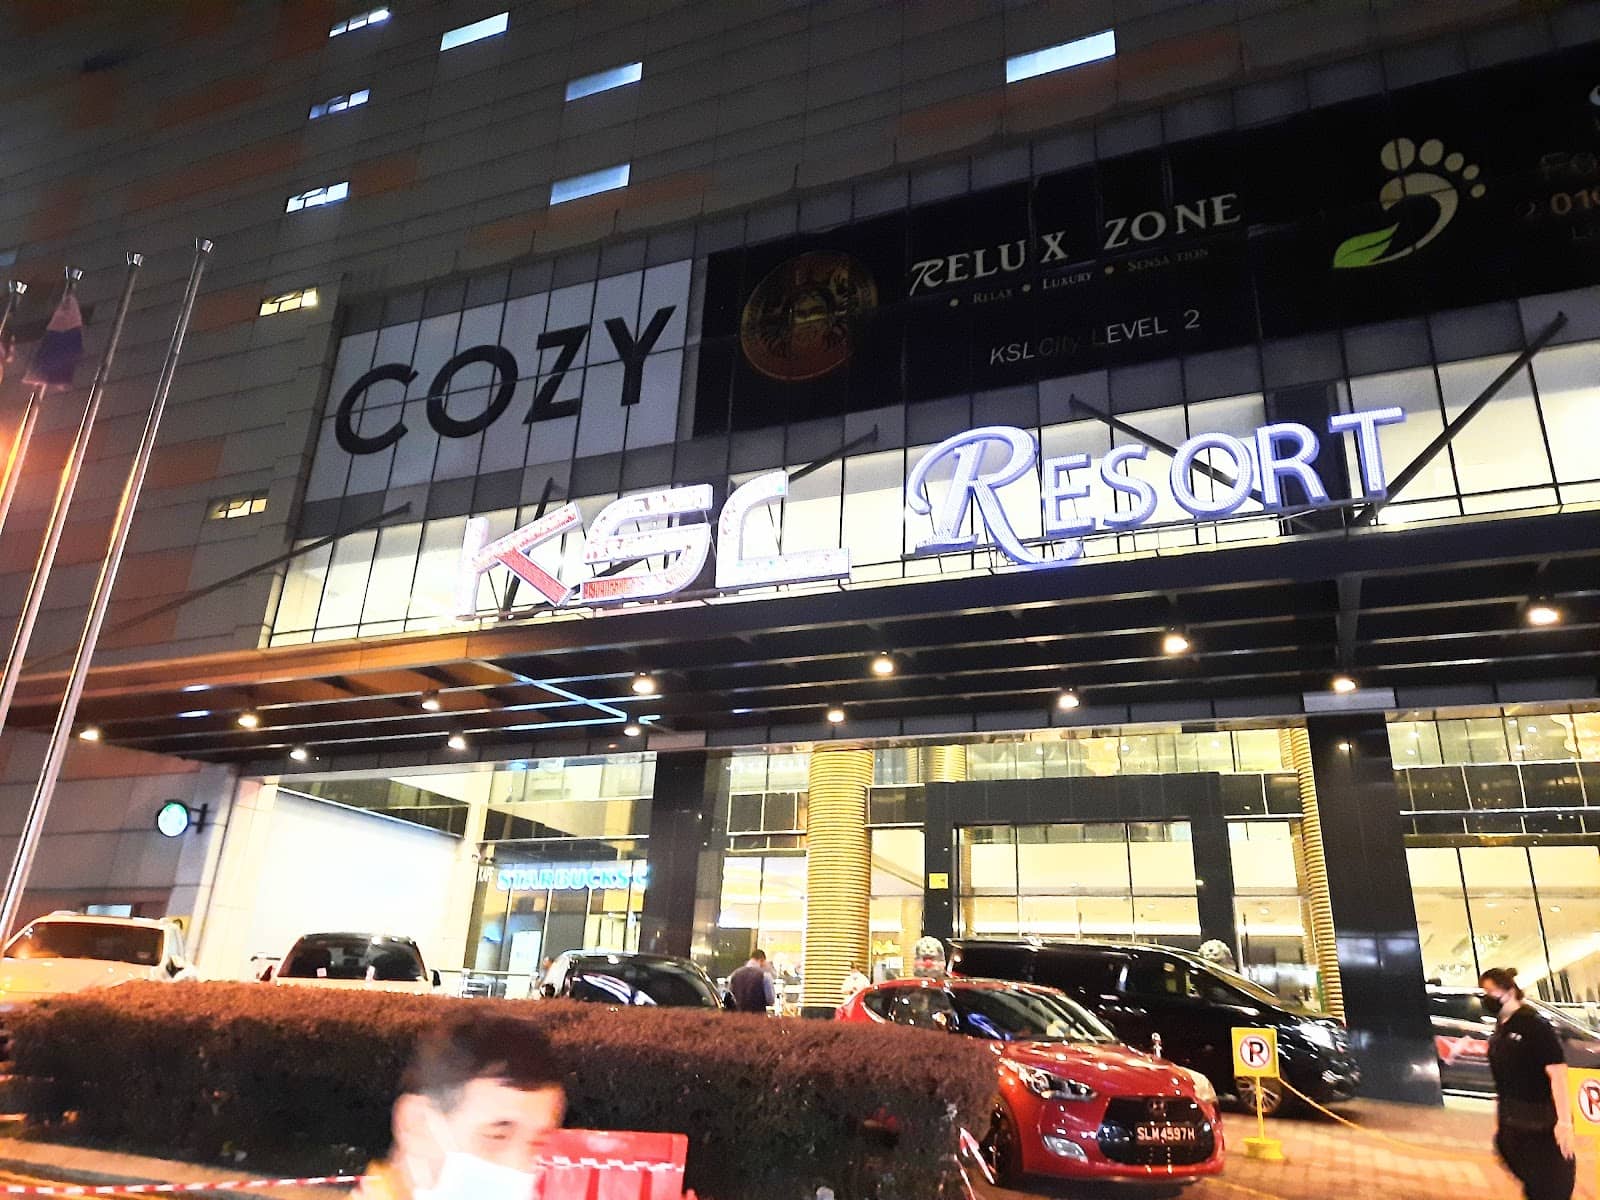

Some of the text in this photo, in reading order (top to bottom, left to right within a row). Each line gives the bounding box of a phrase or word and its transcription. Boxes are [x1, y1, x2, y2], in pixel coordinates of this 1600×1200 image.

[909, 192, 1242, 297] RELUX ZONE
[335, 305, 678, 456] COZY
[1091, 313, 1169, 350] LEVEL
[1183, 308, 1202, 330] 2
[456, 406, 1407, 618] KSL RESORT
[497, 866, 631, 891] STARBUCKS
